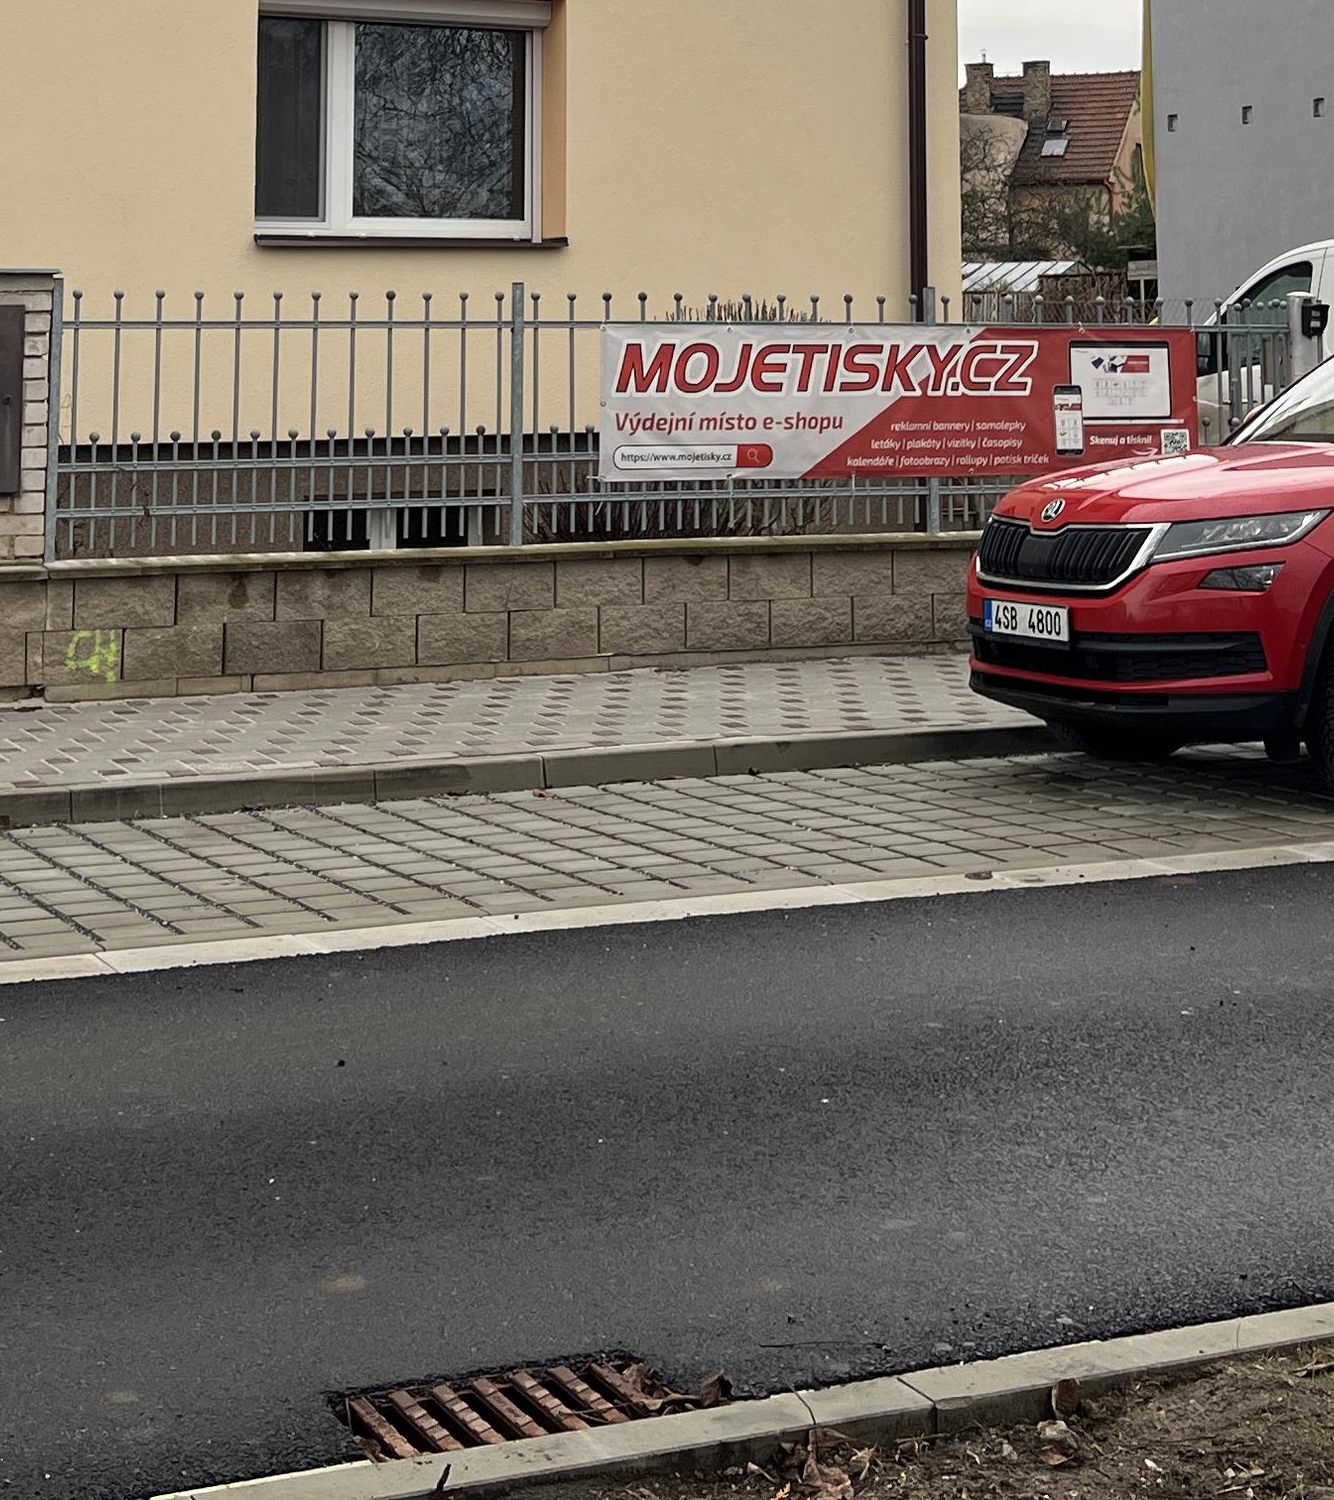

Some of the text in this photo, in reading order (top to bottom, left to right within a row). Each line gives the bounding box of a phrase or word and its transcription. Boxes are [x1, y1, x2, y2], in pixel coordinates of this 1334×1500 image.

[615, 342, 1036, 394] MOJETISKY.CZ
[615, 411, 844, 436] Výdejní místo e-shopu
[890, 420, 931, 432] reklamní
[932, 420, 970, 433] bannery
[975, 419, 1026, 432] samolepky
[871, 438, 901, 451] letáky
[906, 438, 941, 451] plakáty
[947, 437, 976, 450] vizitky
[981, 436, 1022, 450] časopisy
[1089, 435, 1119, 446] Skenuj
[1119, 437, 1126, 445] a
[621, 452, 732, 464] https://www.mojetisky.cz
[847, 455, 895, 467] kalendáře
[899, 455, 950, 468] fotoobrazy
[956, 454, 988, 467] rollupy
[993, 453, 1022, 467] potisk
[1023, 453, 1049, 465] triček
[994, 604, 1061, 636] 4SB 4800
